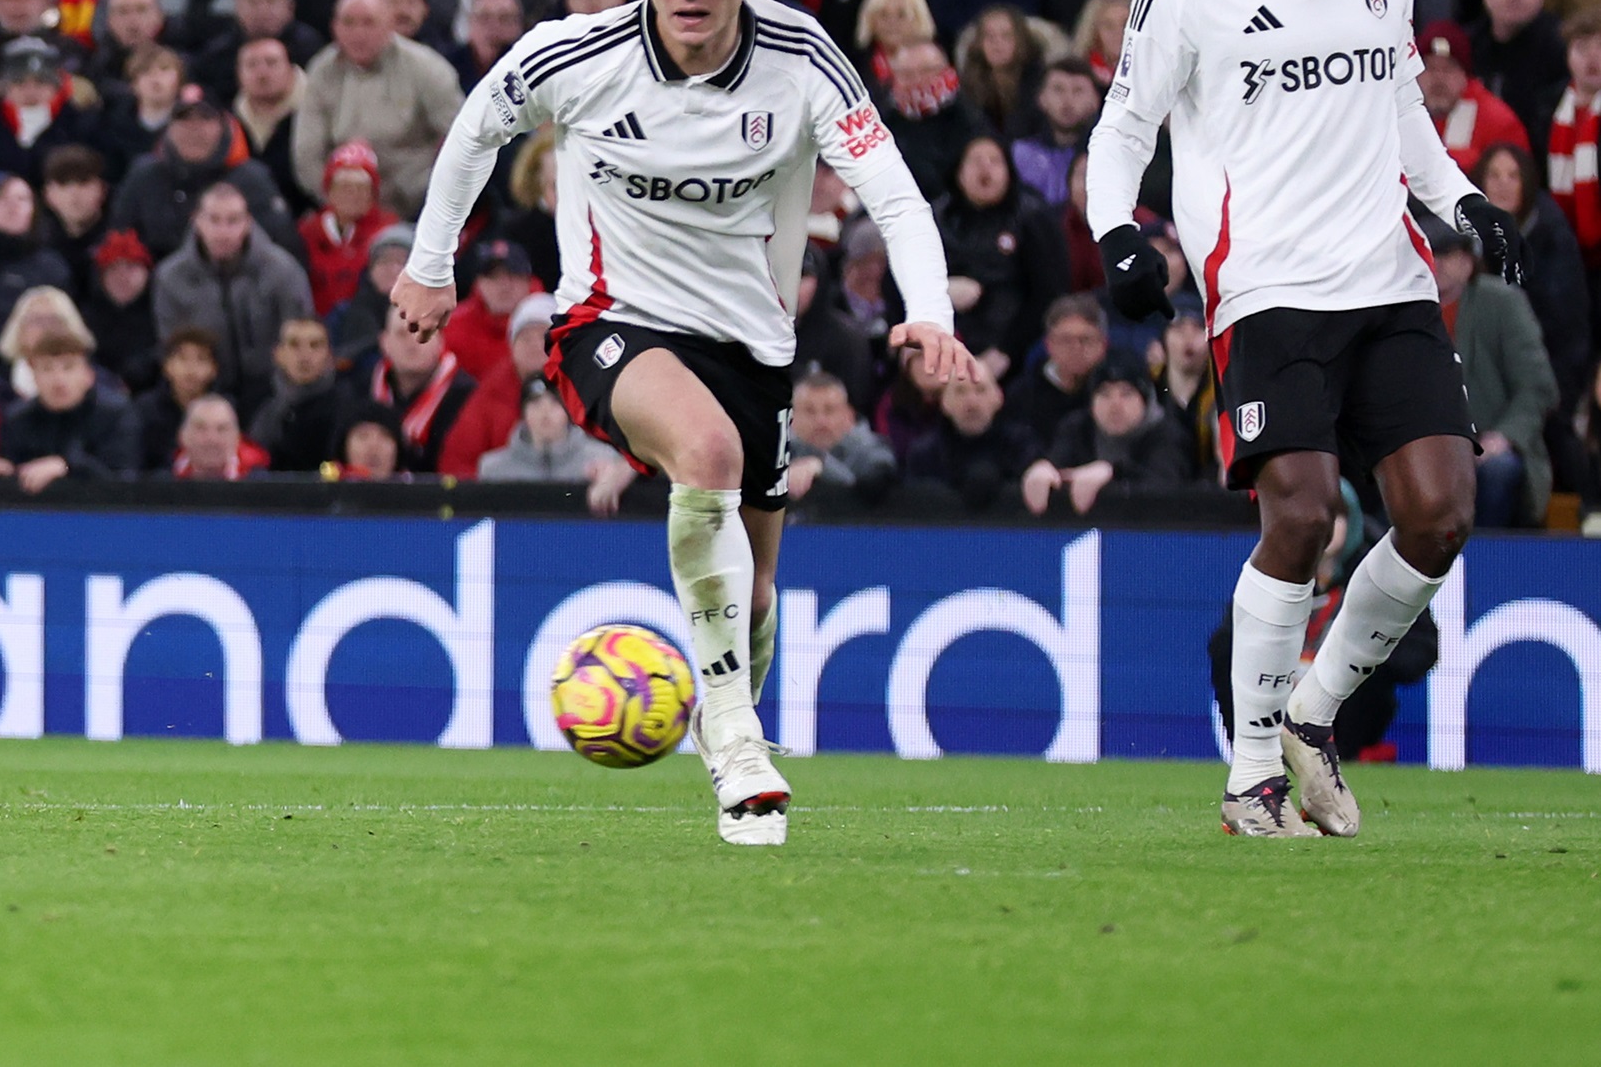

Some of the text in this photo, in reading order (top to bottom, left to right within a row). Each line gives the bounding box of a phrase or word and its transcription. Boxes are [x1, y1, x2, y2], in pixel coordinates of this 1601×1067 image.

[1281, 46, 1397, 93] SBOTOP
[625, 168, 777, 204] SBOTOP
[690, 603, 739, 627] FFC
